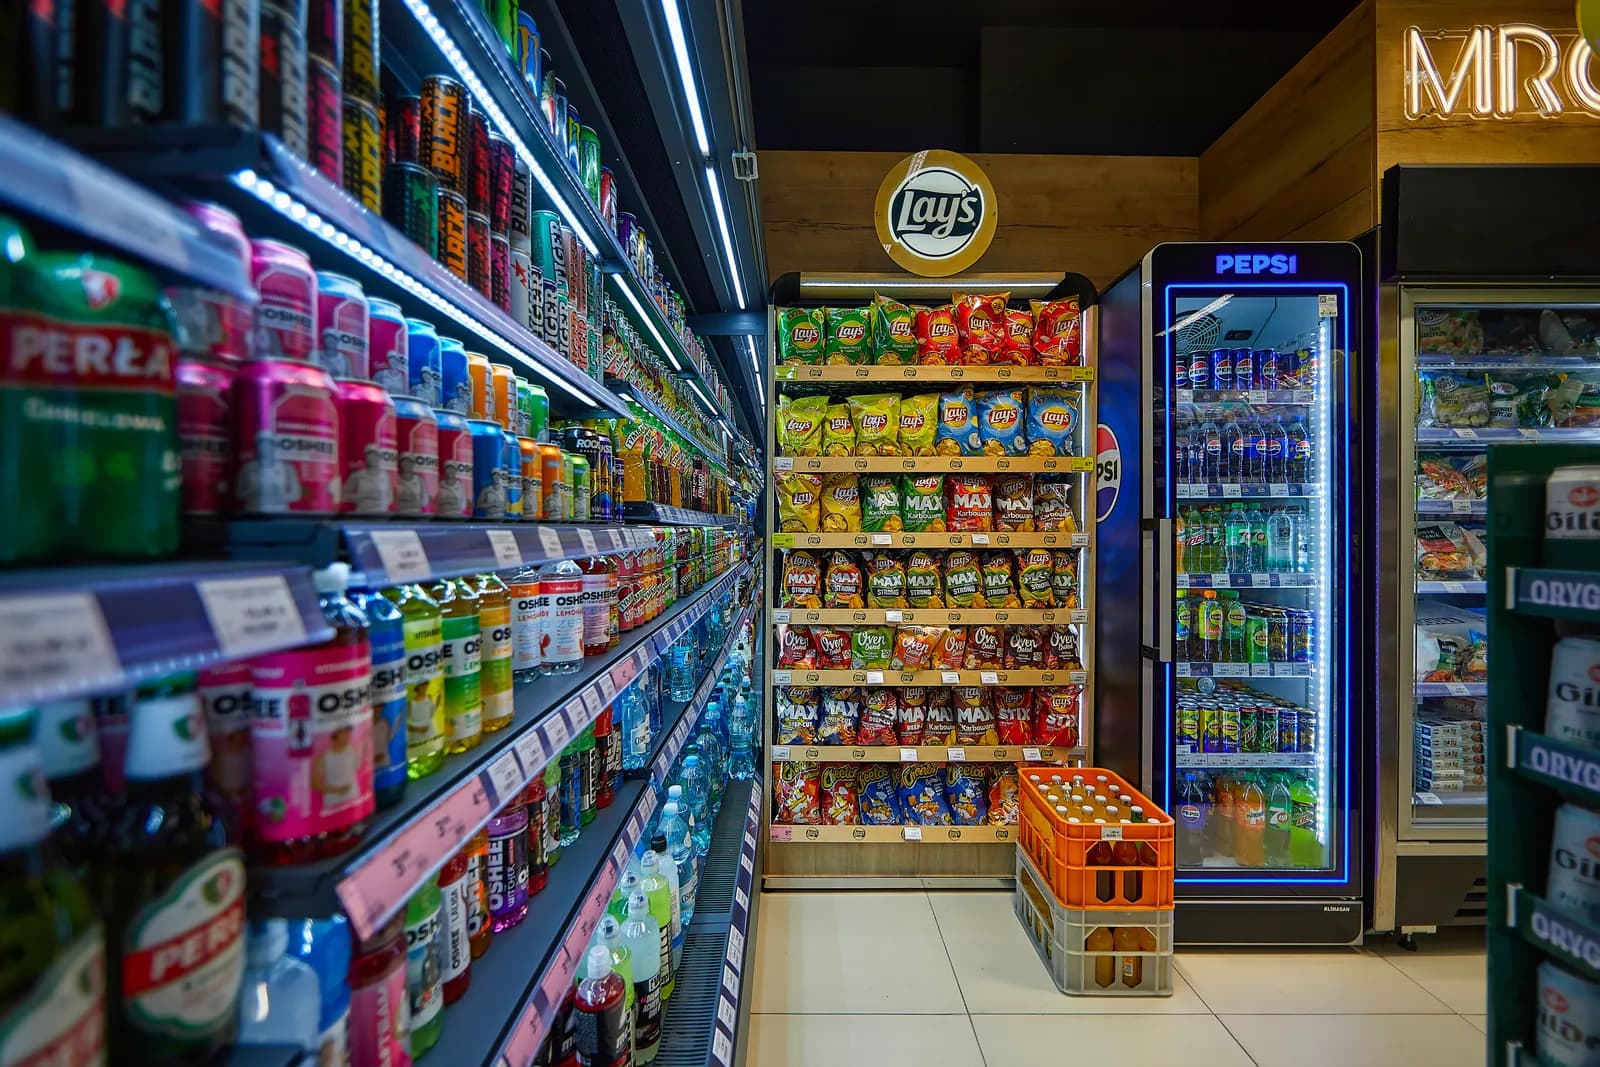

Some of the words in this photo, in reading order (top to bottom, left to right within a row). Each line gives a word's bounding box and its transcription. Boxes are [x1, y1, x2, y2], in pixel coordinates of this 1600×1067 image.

[897, 189, 978, 239] Lay's
[1215, 254, 1297, 275] PEPSI
[11, 325, 172, 380] PERŁA
[1097, 459, 1118, 482] PSI
[906, 495, 943, 511] MAX
[954, 493, 992, 509] MAX
[997, 497, 1033, 511] MAX
[787, 573, 817, 585] MAX
[829, 571, 859, 584] MAX
[873, 574, 903, 586] MAX
[908, 574, 935, 586] MAX
[947, 571, 977, 586] MAX
[910, 587, 933, 597] STRONG
[953, 585, 976, 596] STRONG
[785, 631, 808, 646] Oven
[821, 636, 844, 651] Oven
[857, 631, 887, 646] Oven
[901, 636, 929, 651] Oven
[1010, 633, 1038, 648] Oven
[1050, 631, 1076, 647] Oven
[777, 703, 818, 721] MAX
[957, 706, 995, 723] MAX
[999, 707, 1031, 722] STIX
[488, 839, 503, 911] OSHEE
